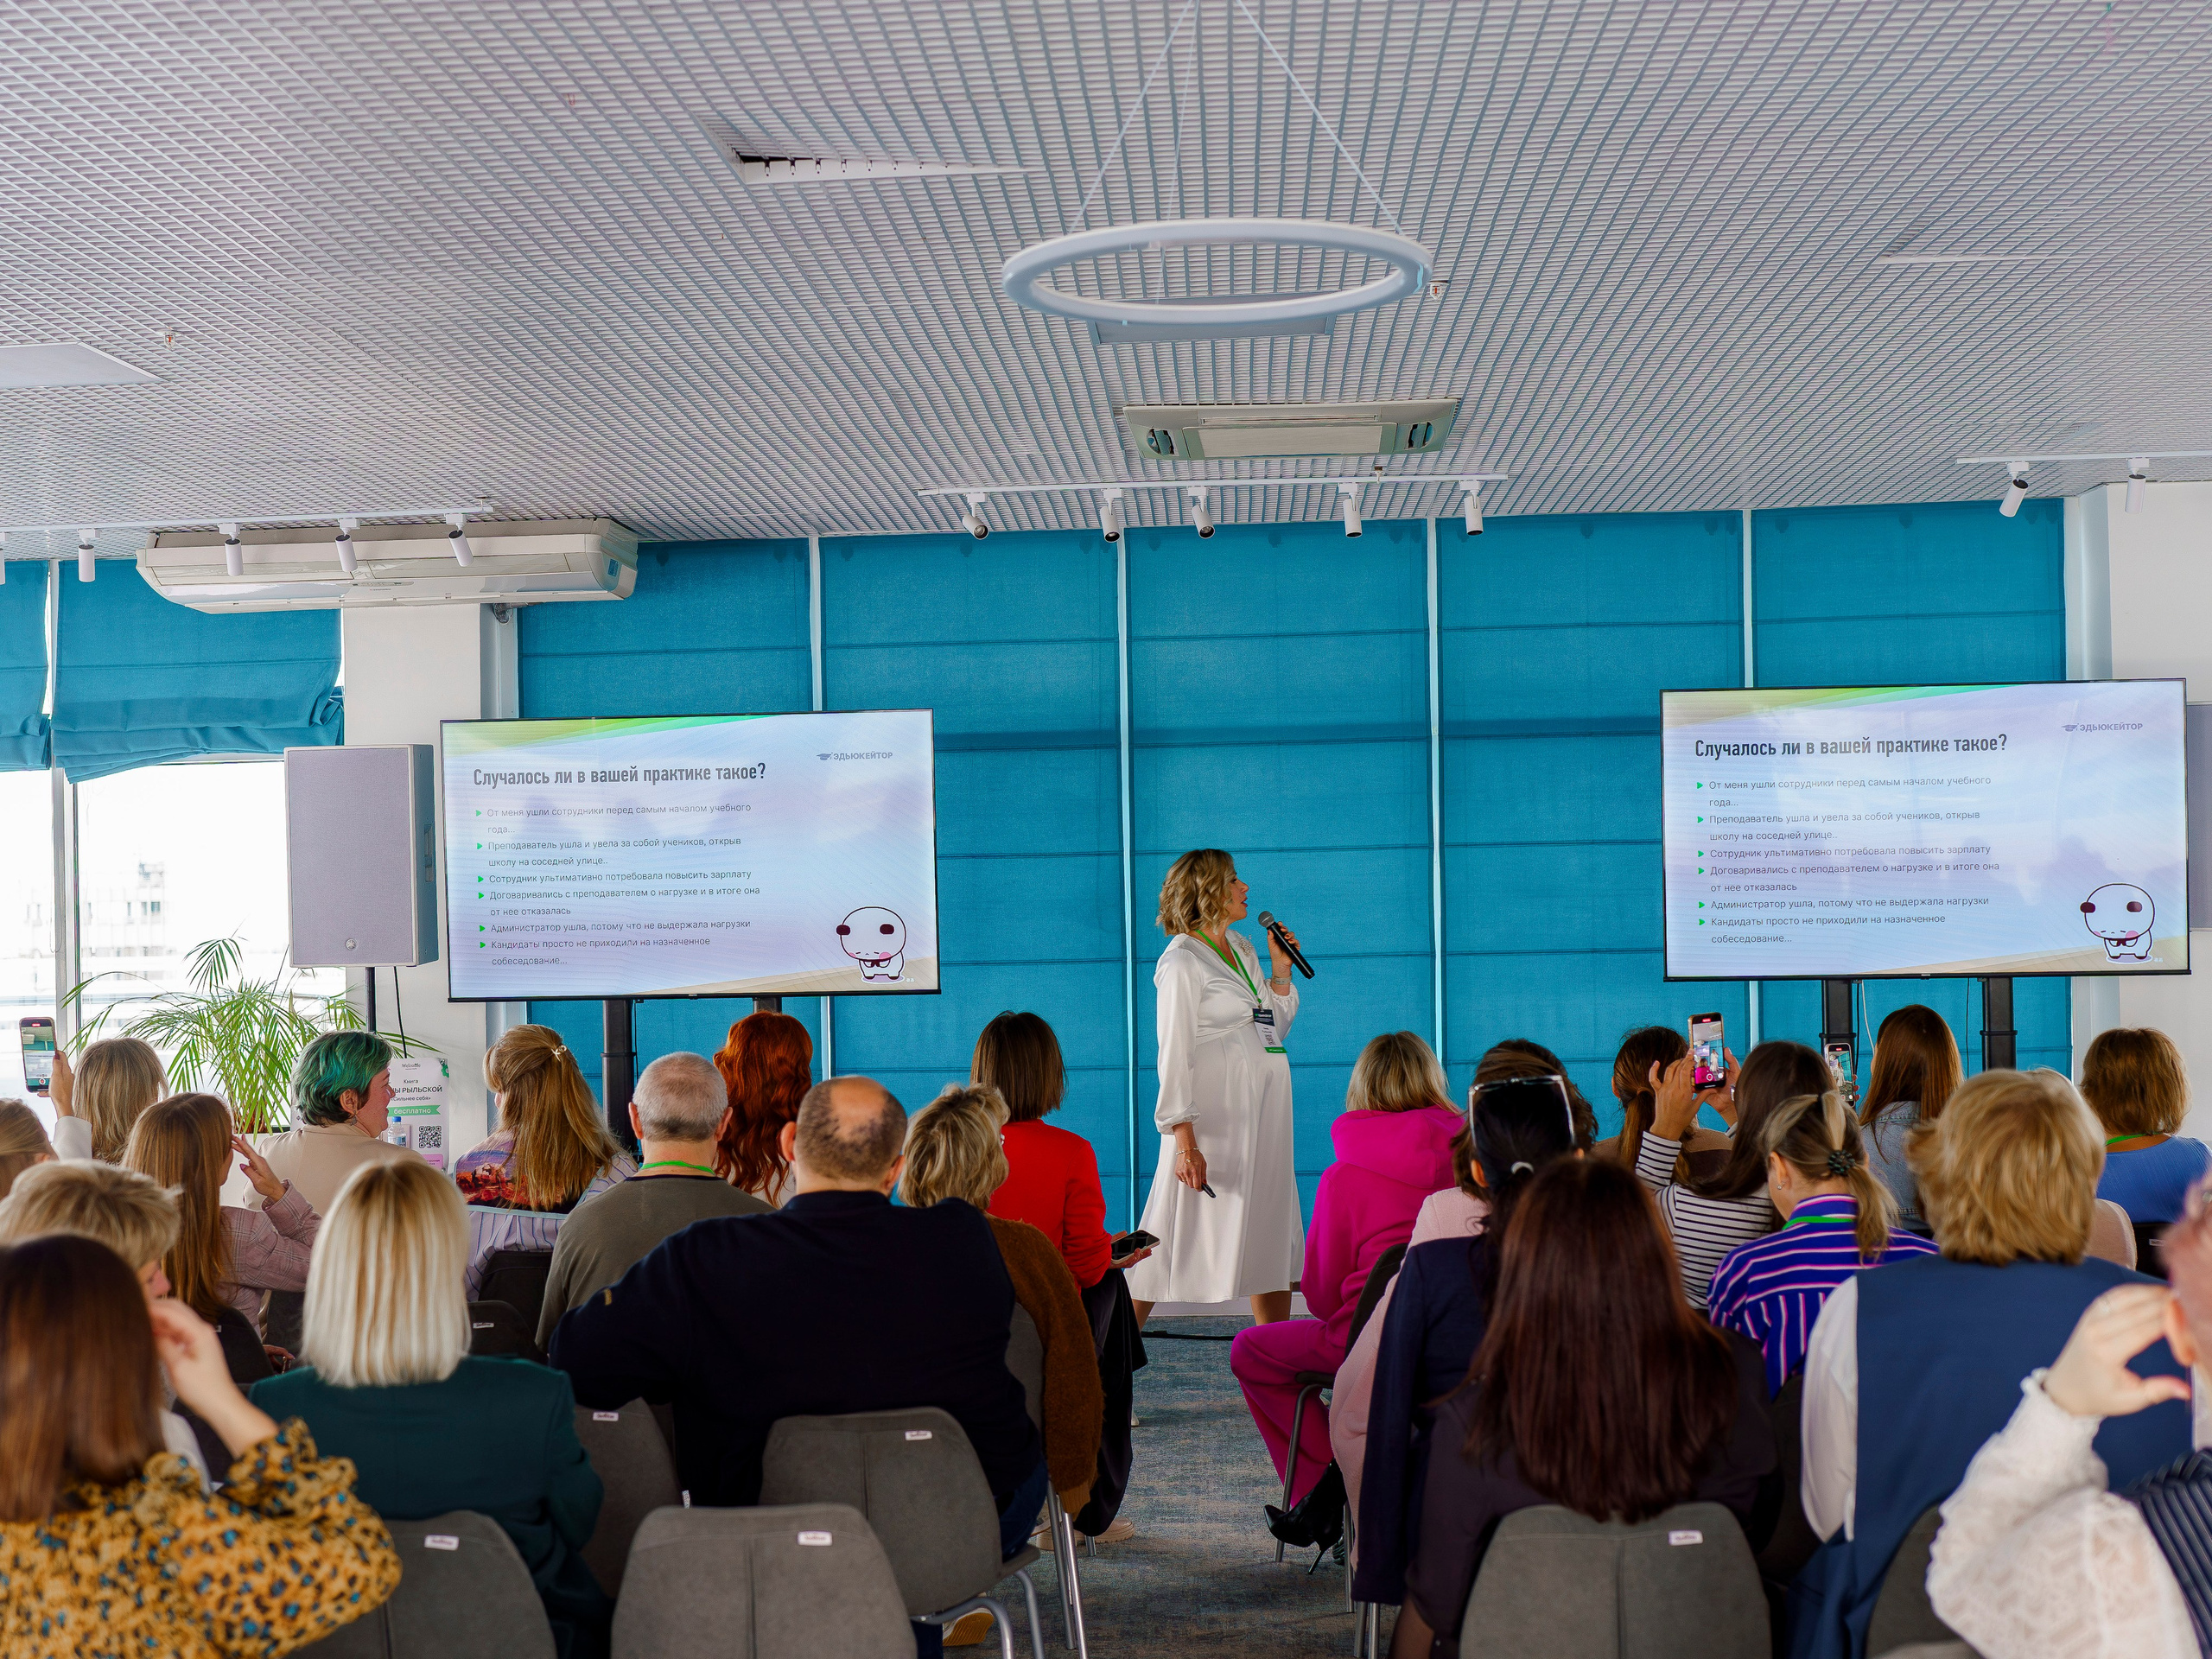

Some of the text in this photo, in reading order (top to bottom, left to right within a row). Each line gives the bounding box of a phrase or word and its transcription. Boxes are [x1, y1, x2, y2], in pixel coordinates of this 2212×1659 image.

[2079, 721, 2144, 733] ЭДЬЮКЕЙТОР
[1695, 733, 2007, 761] Случалось ли в вашей практике такое?
[833, 750, 893, 761] ЭДЬЮКЕЙТОР
[474, 762, 766, 790] Случалось ли в вашей практике такое?
[1708, 780, 1722, 790] От
[1750, 781, 1776, 791] ушли
[1777, 780, 1834, 790] сотрудники
[1836, 779, 1866, 789] перед
[1903, 778, 1944, 786] началом
[1947, 776, 1992, 787] учебного
[486, 808, 499, 817] От
[525, 809, 550, 818] ушли
[551, 808, 604, 817] сотрудники
[606, 807, 634, 816] перед
[709, 803, 752, 814] учебного
[1709, 815, 1783, 825] Преподаватель
[1785, 815, 1810, 824] ушла
[1821, 814, 1849, 823] увела
[1864, 811, 1893, 821] собой
[1895, 812, 1943, 823] учеников,
[1945, 811, 1980, 821] открыв
[1709, 833, 1739, 842] школу
[1755, 830, 1802, 841] соседней
[488, 842, 557, 852] Преподаватель
[559, 841, 582, 851] ушла
[592, 841, 619, 850] увела
[632, 838, 660, 848] собой
[662, 839, 707, 849] учеников,
[709, 838, 741, 847] открыв
[1709, 849, 1762, 860] Сотрудник
[1764, 849, 1832, 859] ультимативно
[1834, 846, 1896, 857] потребовала
[1947, 846, 1992, 855] зарплату
[488, 859, 517, 868] школу
[531, 856, 575, 867] соседней
[1709, 866, 1789, 876] Договаривались
[1799, 865, 1880, 875] преподавателем
[1891, 864, 1934, 874] нагрузке
[488, 874, 537, 885] Сотрудник
[539, 874, 603, 884] ультимативно
[605, 872, 663, 882] потребовала
[710, 871, 752, 880] зарплату
[489, 891, 563, 901] Договаривались
[572, 889, 648, 899] преподавателем
[658, 888, 698, 898] нагрузке
[1710, 900, 1787, 911] Администратор
[1788, 900, 1815, 910] ушла,
[1818, 899, 1853, 909] потому
[1889, 898, 1944, 908] выдержала
[1946, 898, 1989, 907] нагрузки
[520, 907, 571, 916] отказалась
[490, 924, 562, 934] Администратор
[563, 924, 588, 933] ушла,
[591, 924, 624, 932] потому
[657, 921, 709, 931] выдержала
[710, 920, 751, 930] нагрузки
[1711, 918, 1764, 927] Кандидаты
[1765, 918, 1800, 927] просто
[1815, 917, 1868, 926] приходили
[1884, 915, 1946, 924] назначенное
[491, 940, 540, 950] Кандидаты
[542, 940, 575, 950] просто
[589, 939, 638, 949] приходили
[652, 938, 710, 946] назначенное
[402, 1084, 442, 1094] РЫЛЬСКОЙ
